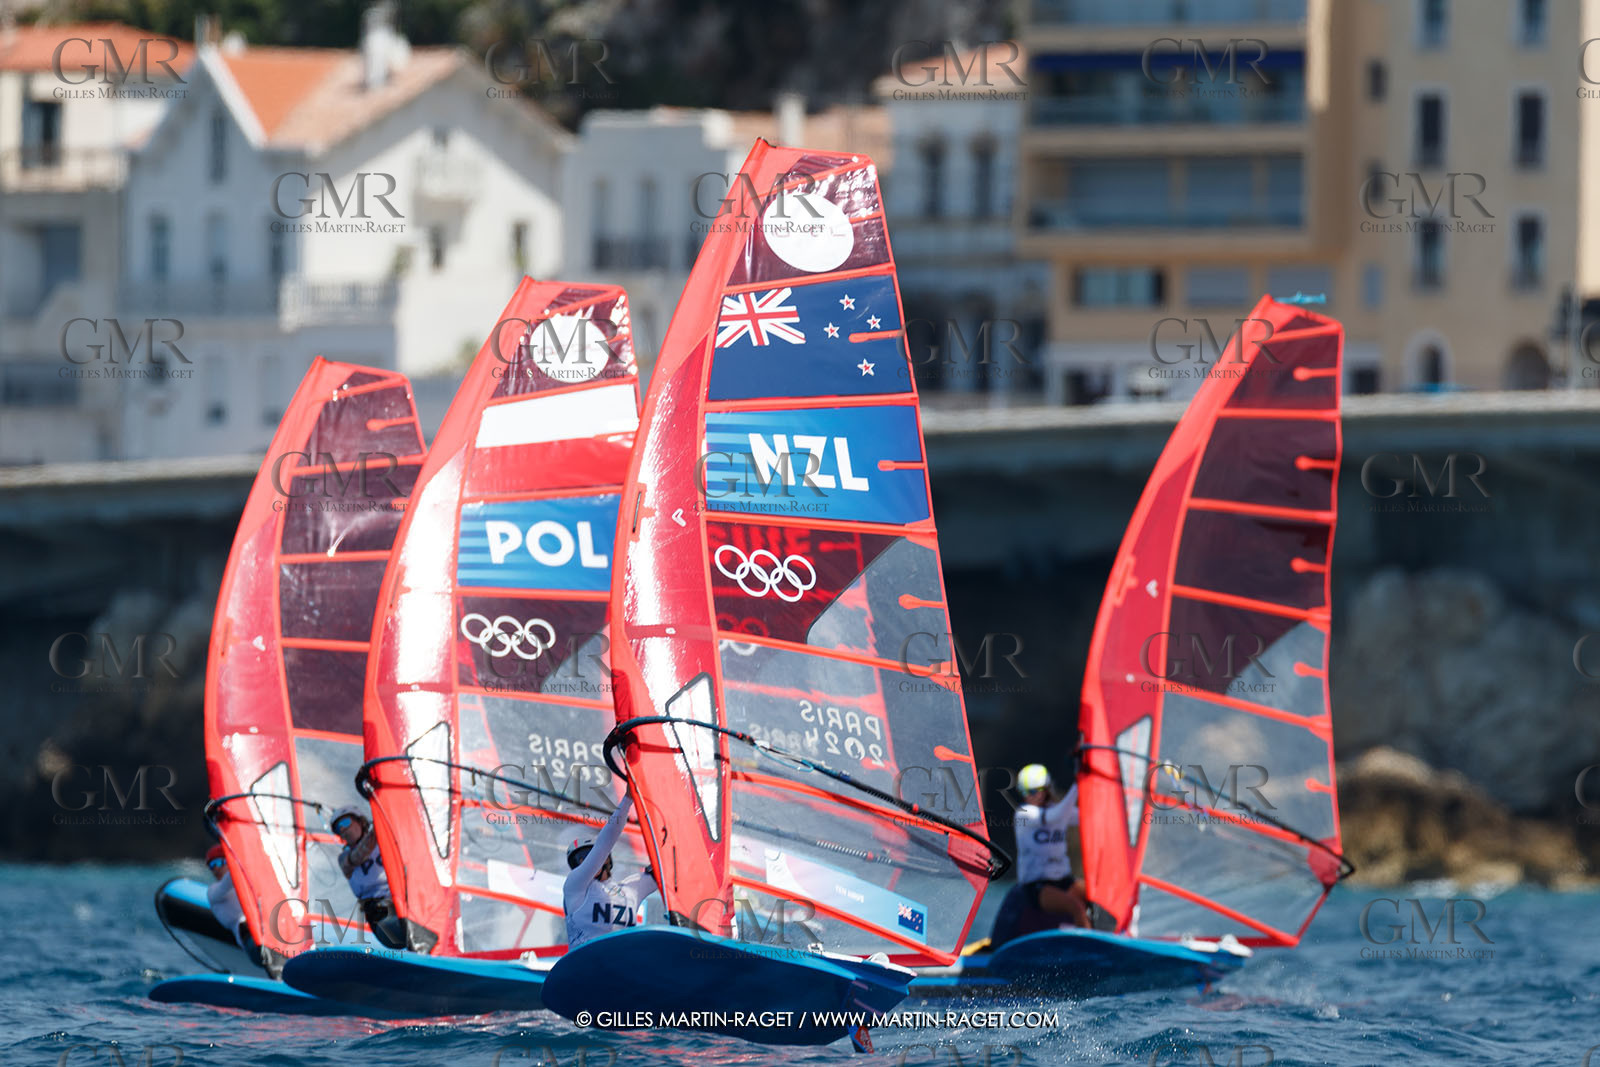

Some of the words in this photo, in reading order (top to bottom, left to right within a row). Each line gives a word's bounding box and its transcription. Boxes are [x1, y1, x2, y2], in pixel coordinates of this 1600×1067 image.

[748, 433, 870, 491] NZL
[485, 520, 609, 568] POL
[592, 902, 636, 927] NZL
